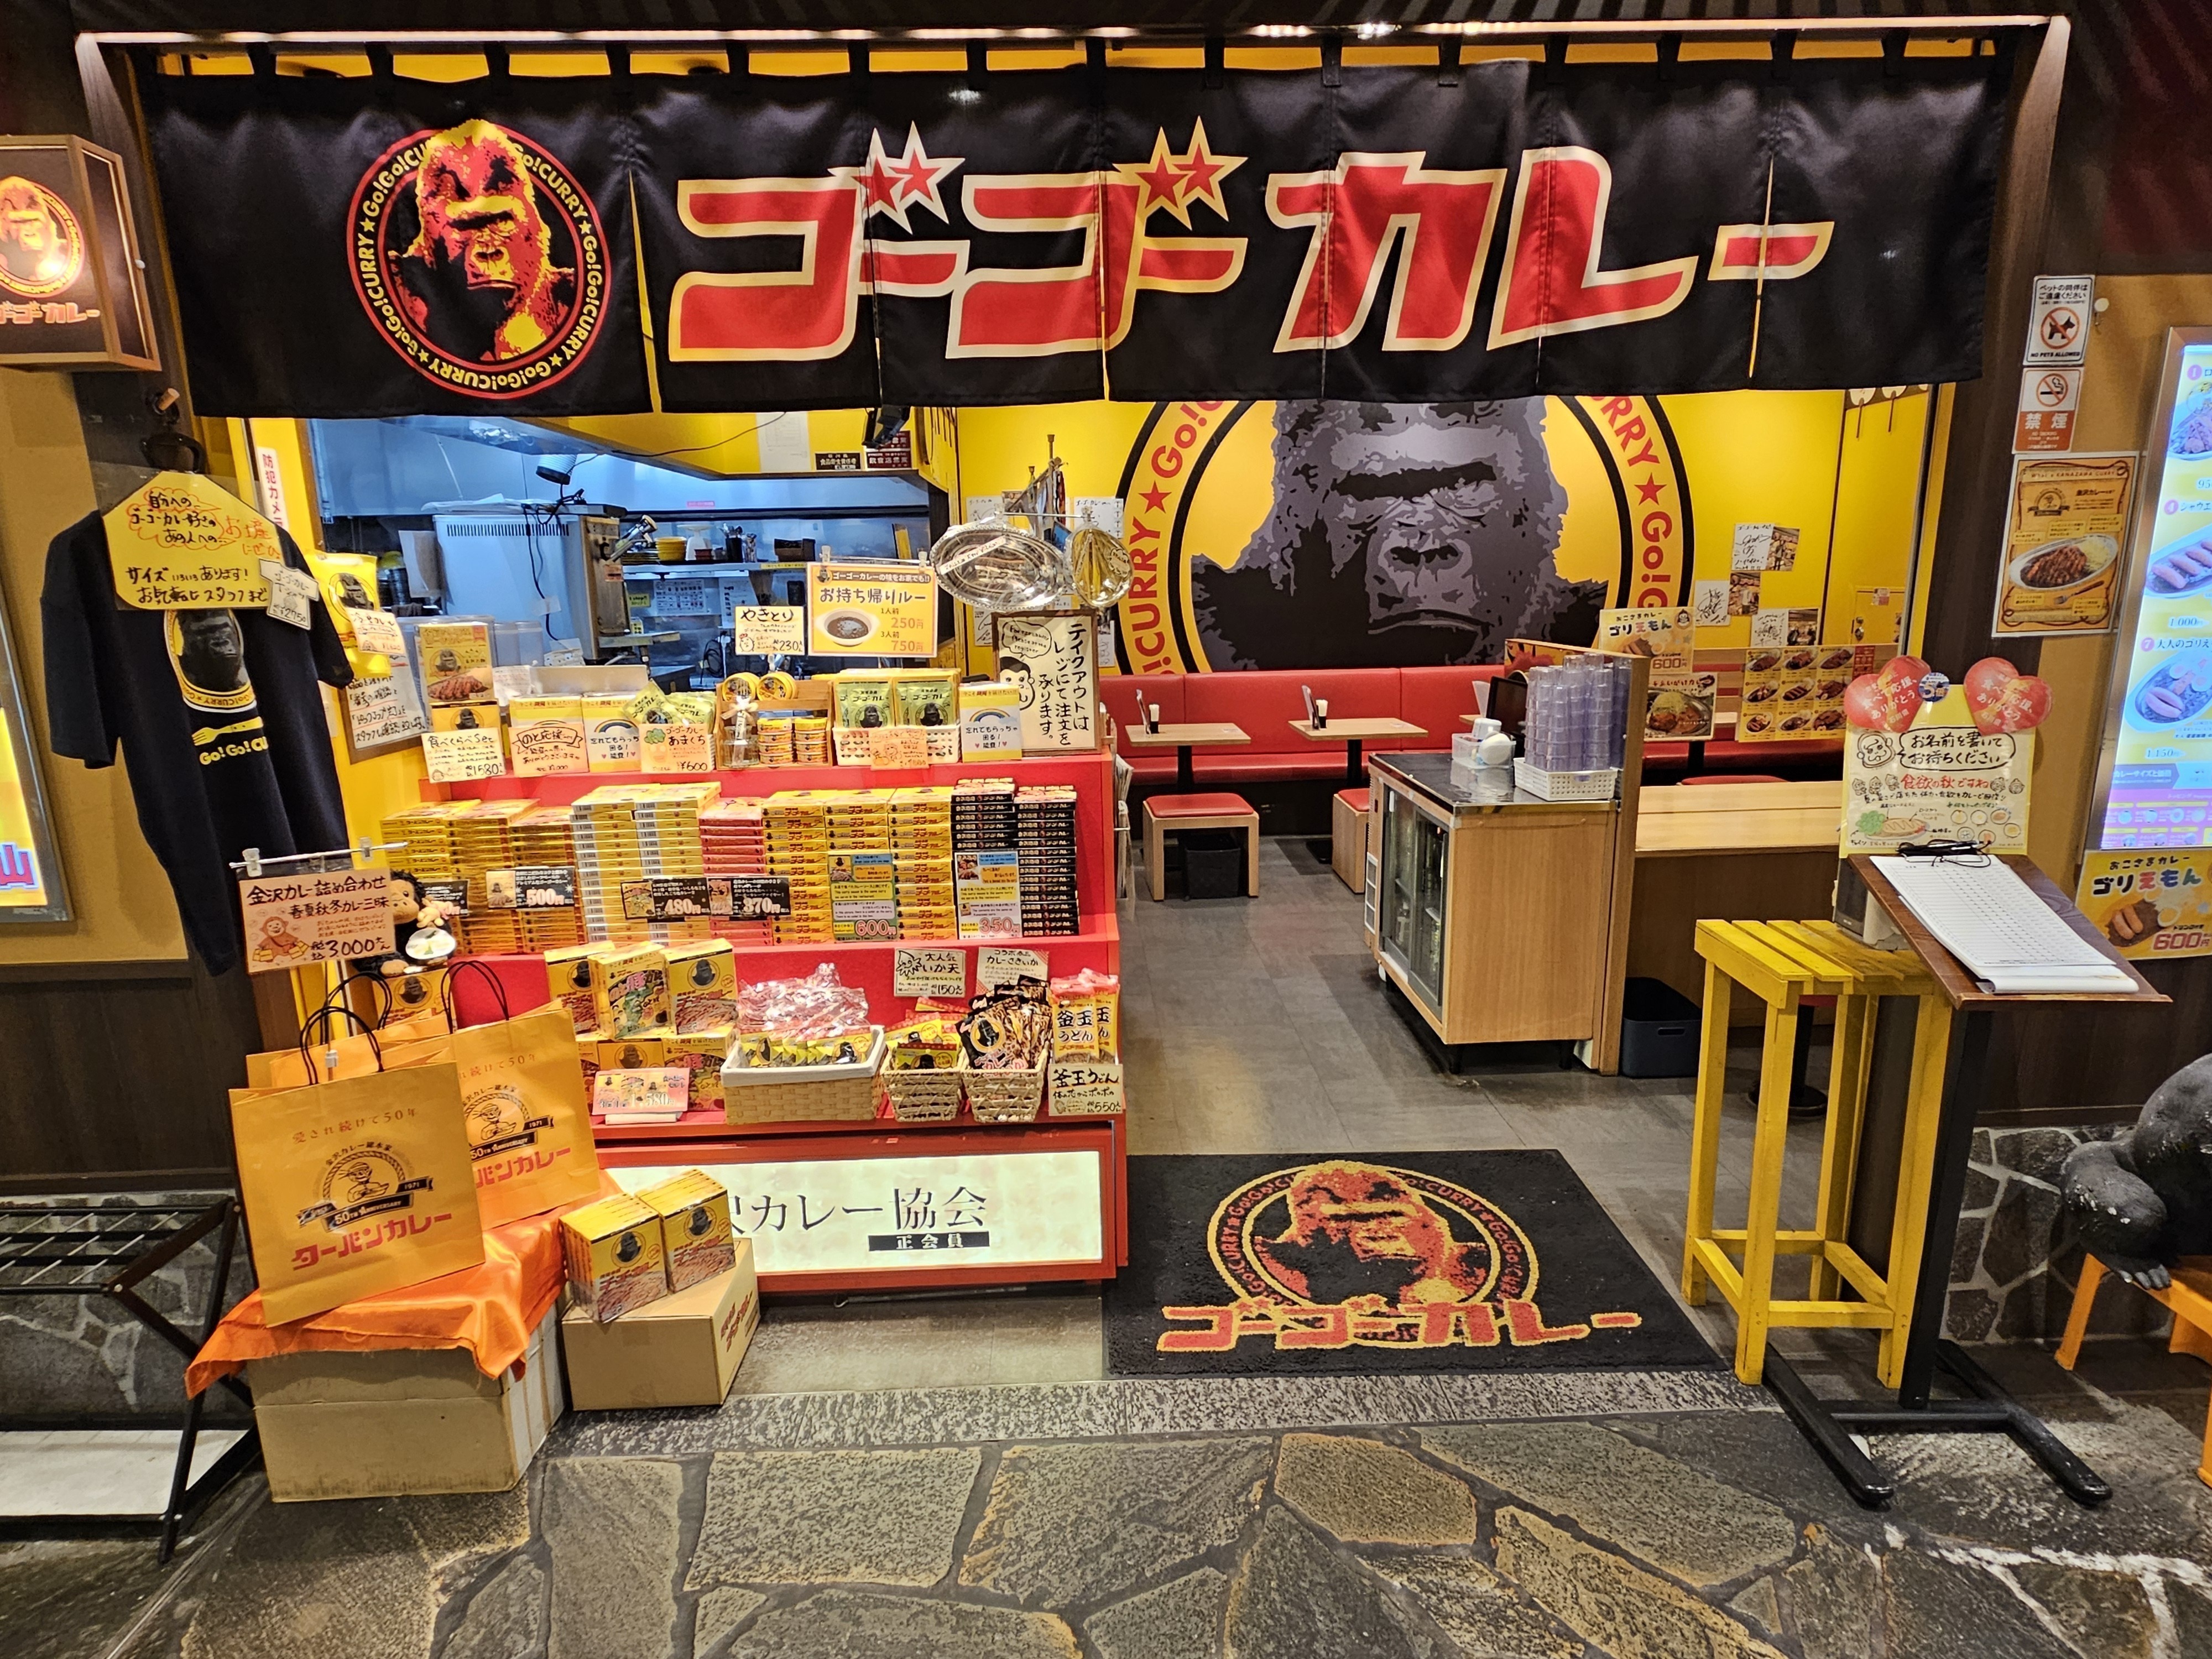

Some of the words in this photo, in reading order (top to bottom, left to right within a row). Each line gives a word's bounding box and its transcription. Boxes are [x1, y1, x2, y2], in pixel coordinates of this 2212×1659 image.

[669, 116, 1834, 362] ゴーゴーカレー
[2025, 413, 2069, 430] 禁煙
[820, 587, 926, 605] お持ち帰りルー
[740, 608, 795, 622] やきとり
[2157, 638, 2212, 649] 大人のゴリえ
[1068, 623, 1090, 732] テイクアウトは
[1054, 640, 1072, 746] レジにて注文を
[1037, 674, 1055, 739] 承ります。
[669, 735, 707, 747] あまくち
[1911, 732, 2003, 748] お名前を書いて
[1908, 749, 2000, 766] お待ちください
[1900, 774, 1989, 790] 食欲の秋ですね
[2109, 855, 2190, 870] おこさまカレー
[2093, 868, 2201, 895] ゴリえもん
[247, 875, 387, 906] 金沢カレー詰め合わせ
[289, 896, 389, 919] 春夏秋冬カレー三昧
[922, 962, 961, 974] いか天
[1057, 1010, 1094, 1028] 釜玉
[1058, 1030, 1093, 1043] うどん
[1052, 1068, 1119, 1089] 釜玉うどん
[292, 1108, 416, 1144] 愛され続けて50年
[404, 1181, 420, 1190] 1971
[290, 1213, 452, 1271] ターバンカレー
[896, 1233, 966, 1250] 正会員
